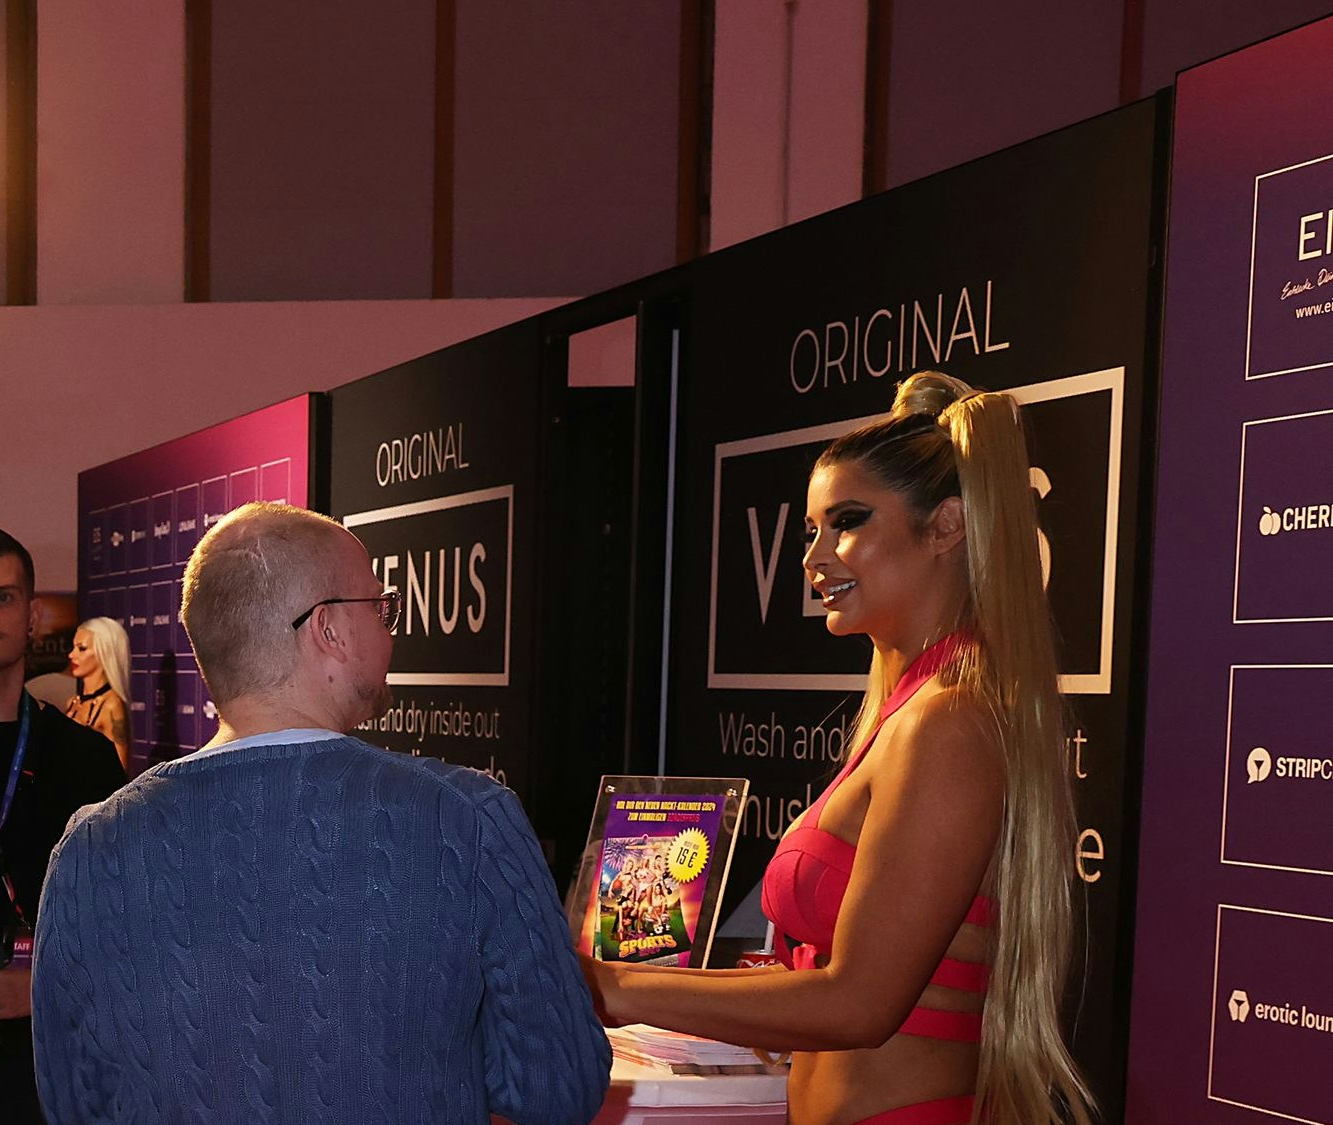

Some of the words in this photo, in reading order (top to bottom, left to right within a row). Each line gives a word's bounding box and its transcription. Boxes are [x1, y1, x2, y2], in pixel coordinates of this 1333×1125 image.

[790, 280, 1011, 394] ORIGINAL
[376, 422, 470, 488] ORIGINAL
[1282, 504, 1333, 532] CHER
[373, 542, 487, 637] ENUS
[405, 700, 427, 742] dry
[430, 702, 471, 738] inside
[474, 707, 501, 740] out
[719, 711, 785, 758] Wash
[793, 713, 845, 764] and
[676, 846, 689, 865] 15
[687, 851, 698, 869] €
[13, 942, 30, 951] TAFF
[619, 934, 678, 959] SPORTS
[1255, 1003, 1299, 1026] erotic
